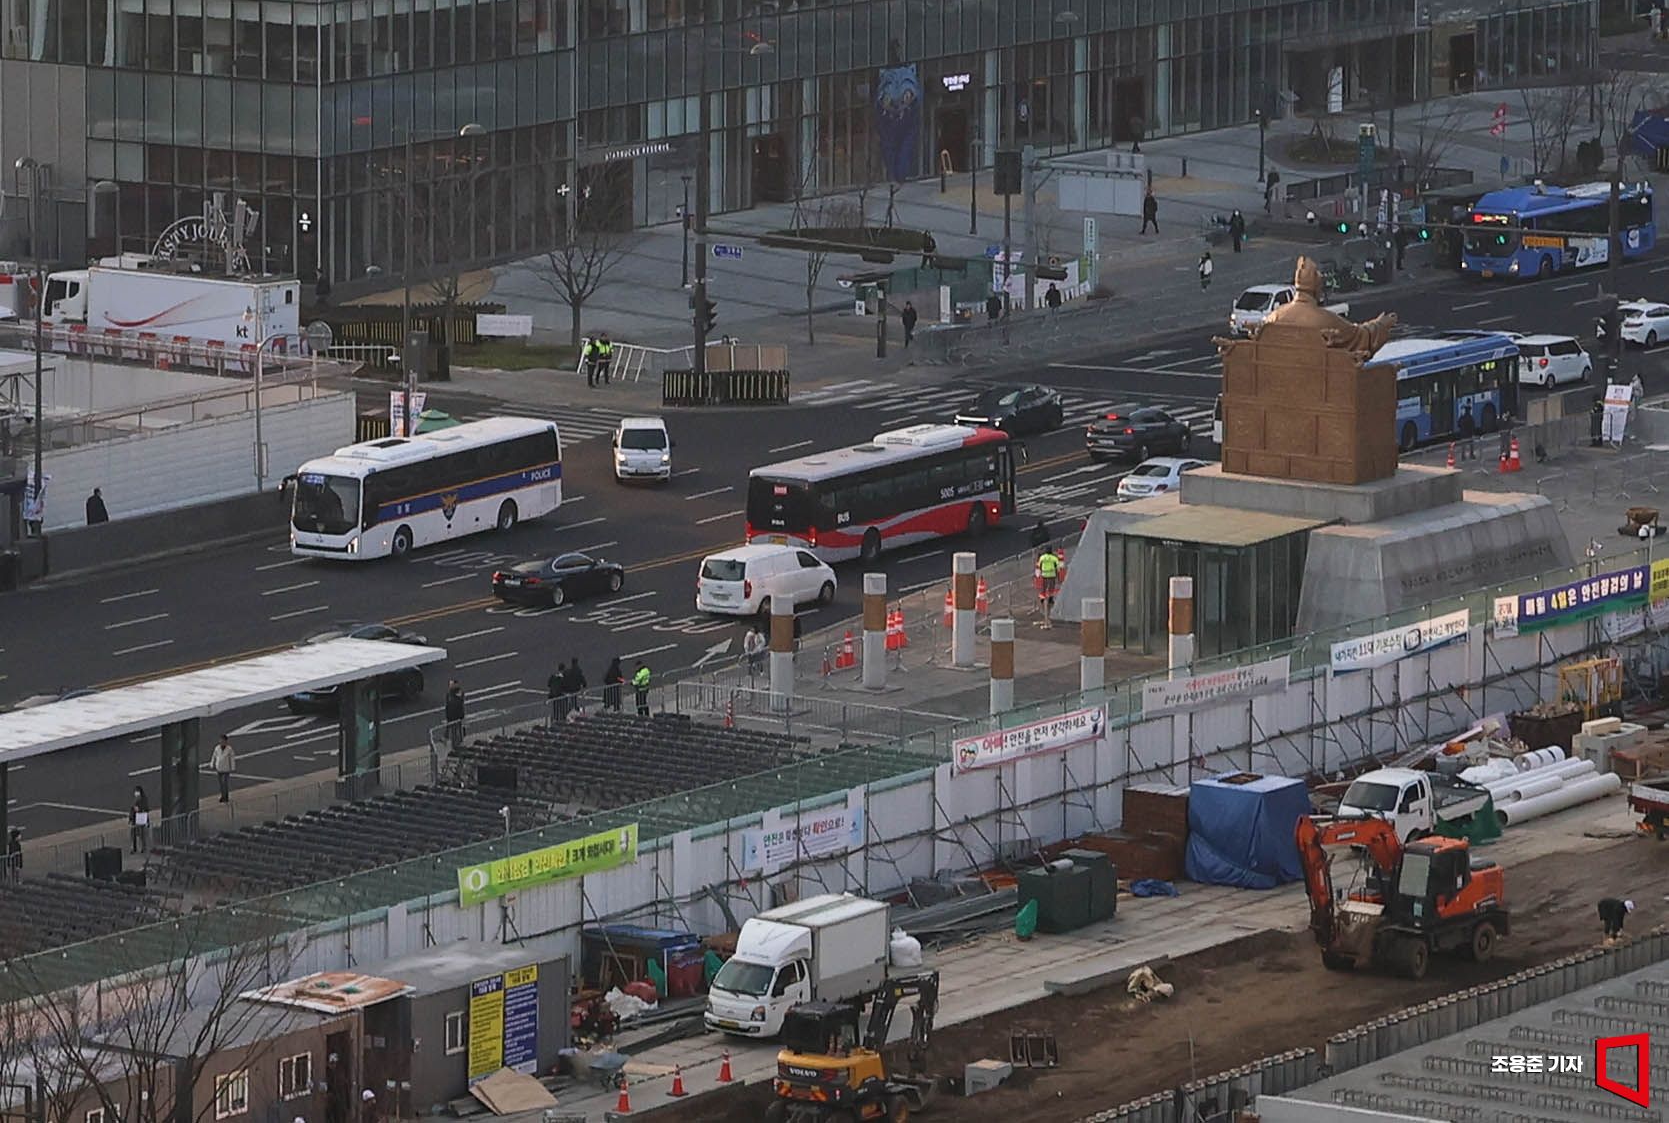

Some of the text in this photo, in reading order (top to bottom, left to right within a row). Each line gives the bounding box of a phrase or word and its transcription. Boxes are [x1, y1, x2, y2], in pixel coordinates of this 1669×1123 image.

[236, 324, 249, 338] kt
[530, 467, 551, 482] POLICE
[1050, 715, 1087, 737] 생각하세요
[790, 1067, 817, 1077] VOLVO
